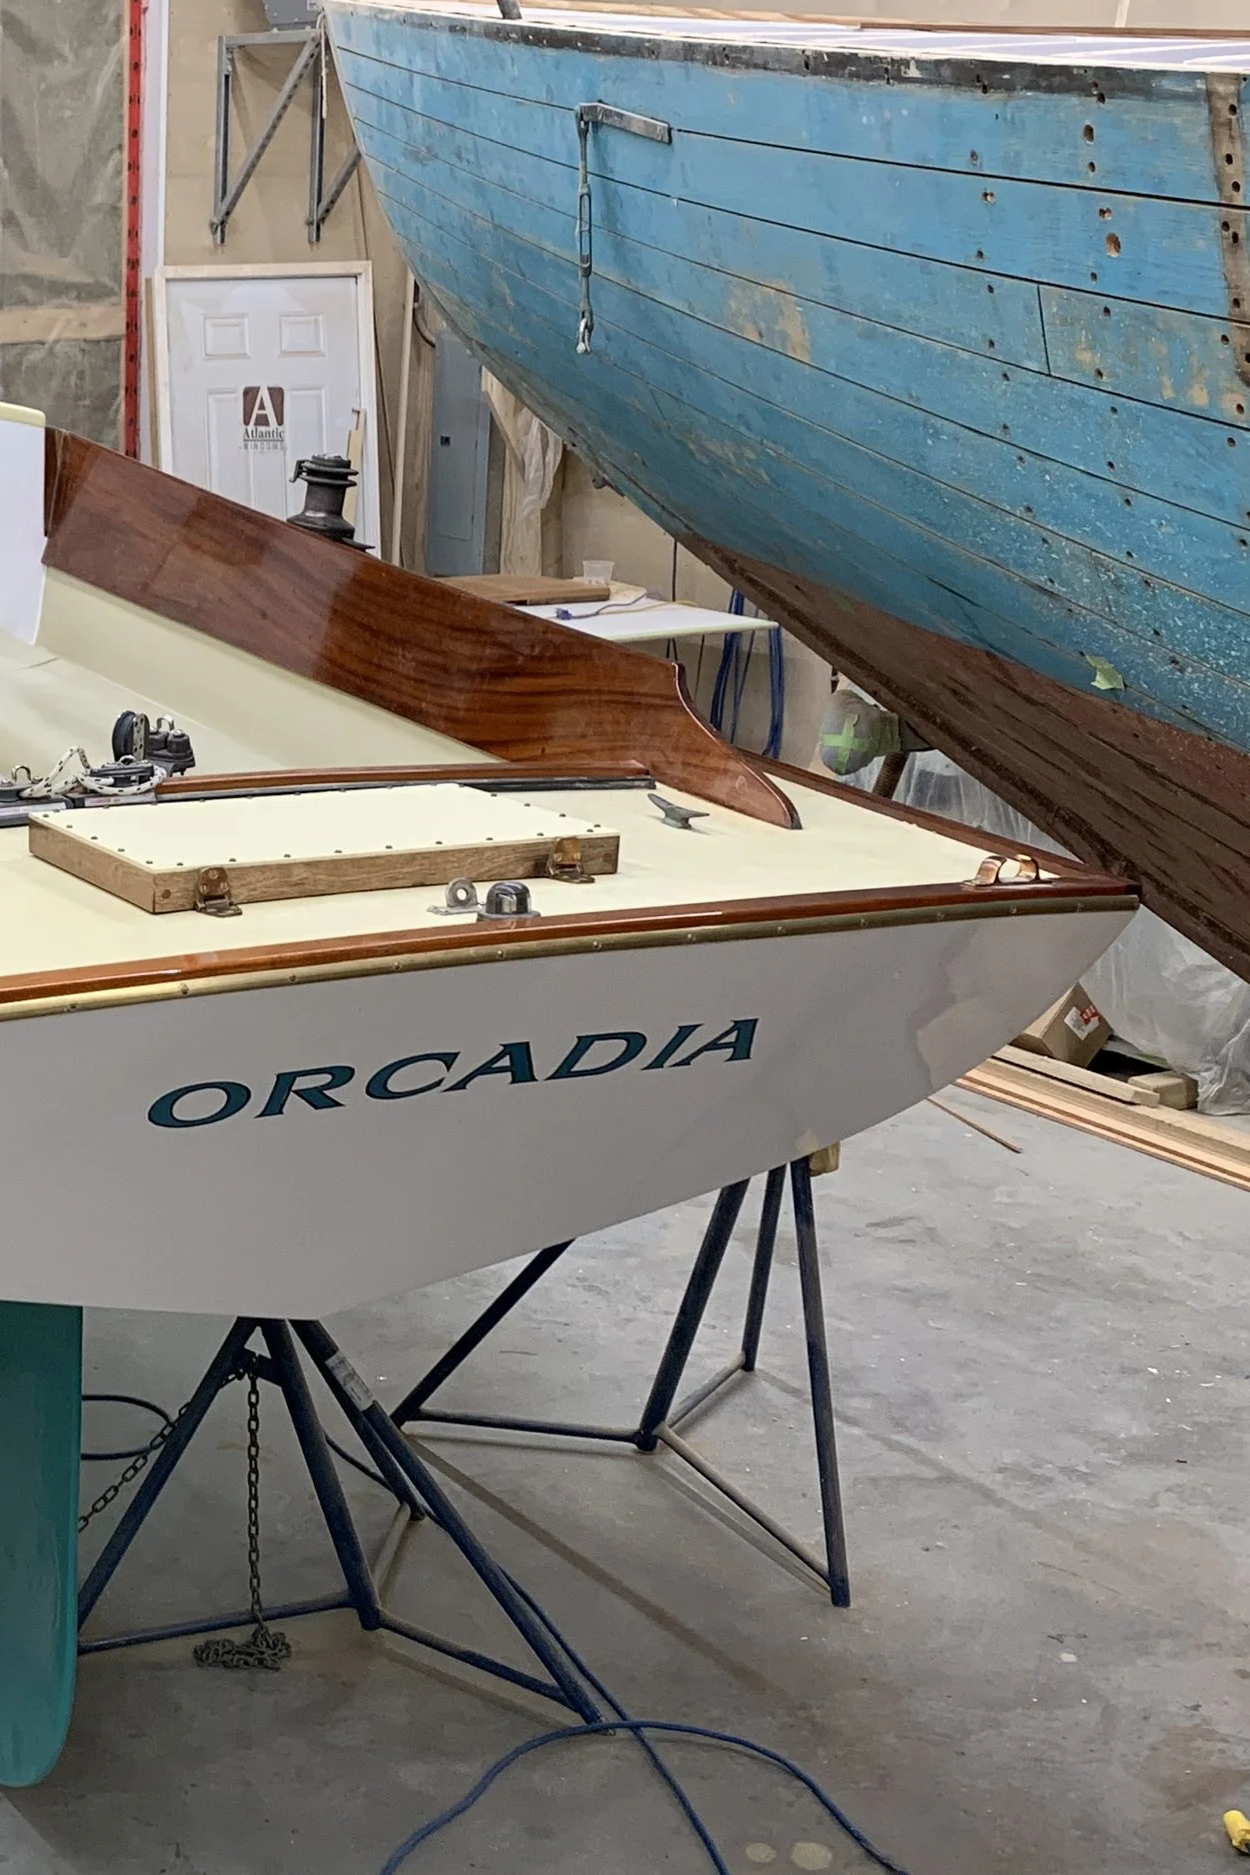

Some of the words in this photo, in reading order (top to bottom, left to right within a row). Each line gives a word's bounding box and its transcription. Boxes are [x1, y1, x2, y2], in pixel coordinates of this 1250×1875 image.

[248, 386, 280, 427] A
[243, 427, 285, 439] Atlantic
[147, 1017, 759, 1128] ORCADIA
